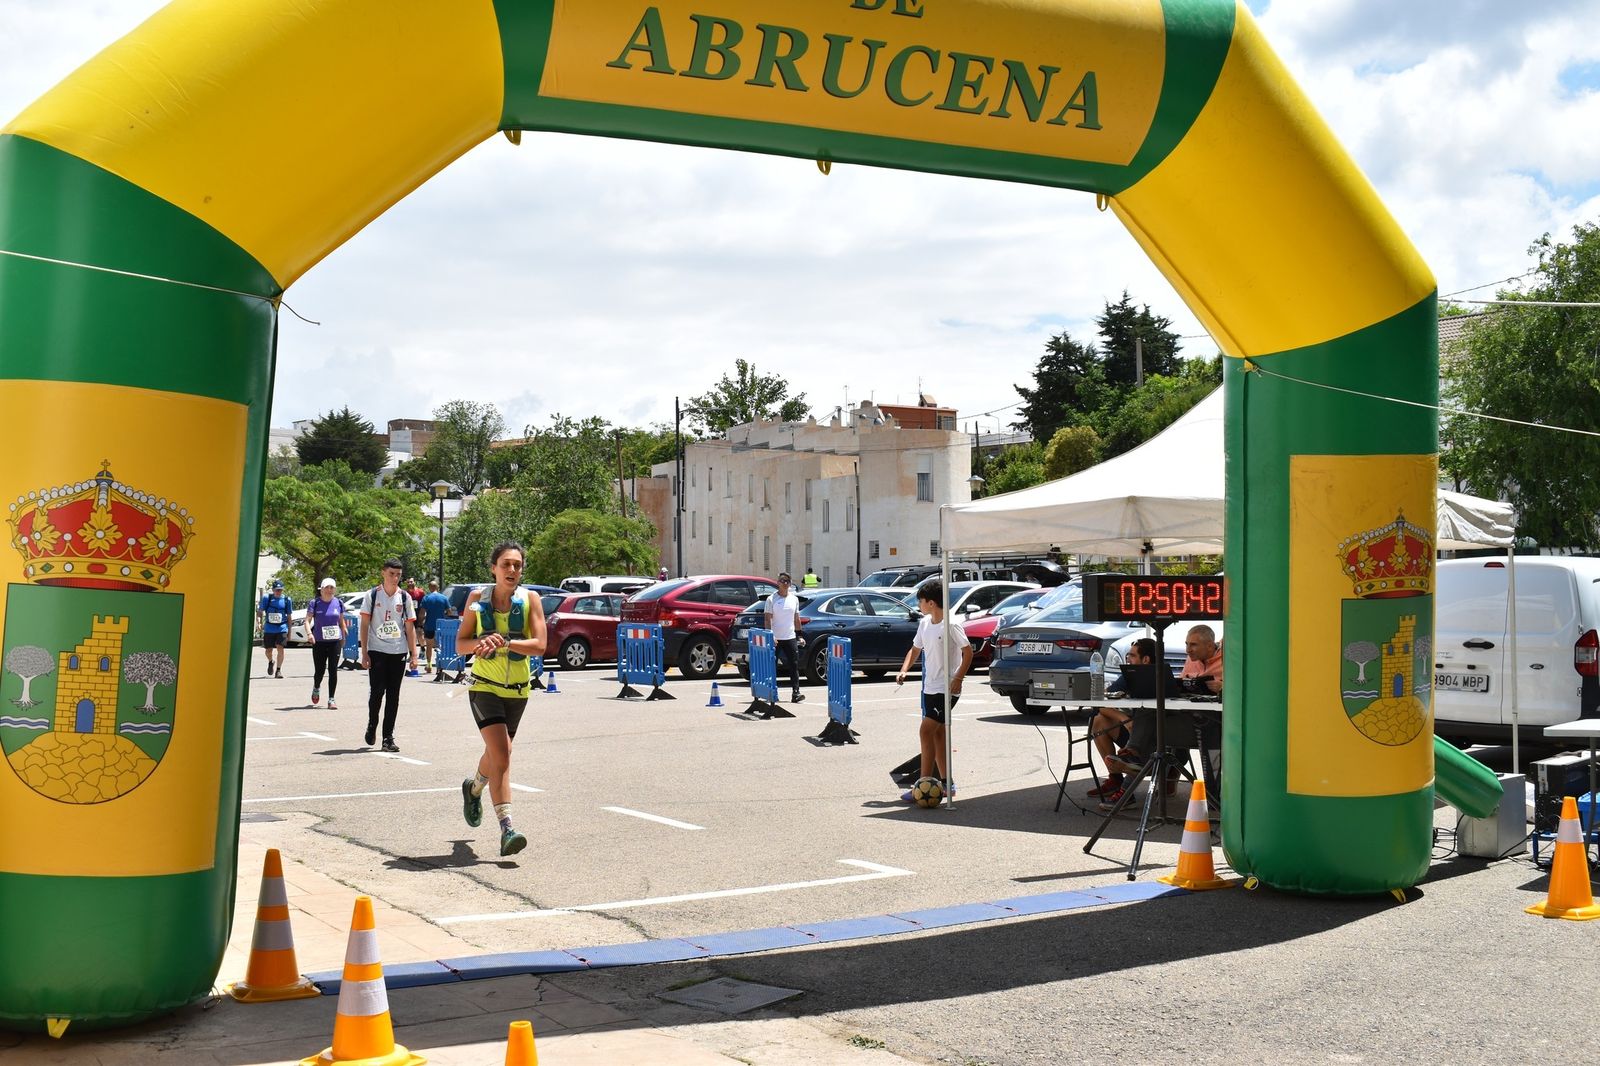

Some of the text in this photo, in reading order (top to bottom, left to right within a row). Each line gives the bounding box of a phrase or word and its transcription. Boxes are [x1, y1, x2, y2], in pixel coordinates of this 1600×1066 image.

[606, 6, 1103, 131] ABRUCENA
[1120, 582, 1220, 614] 02:50:42
[1020, 643, 1052, 652] 9268 JNT
[1463, 675, 1484, 688] MBP
